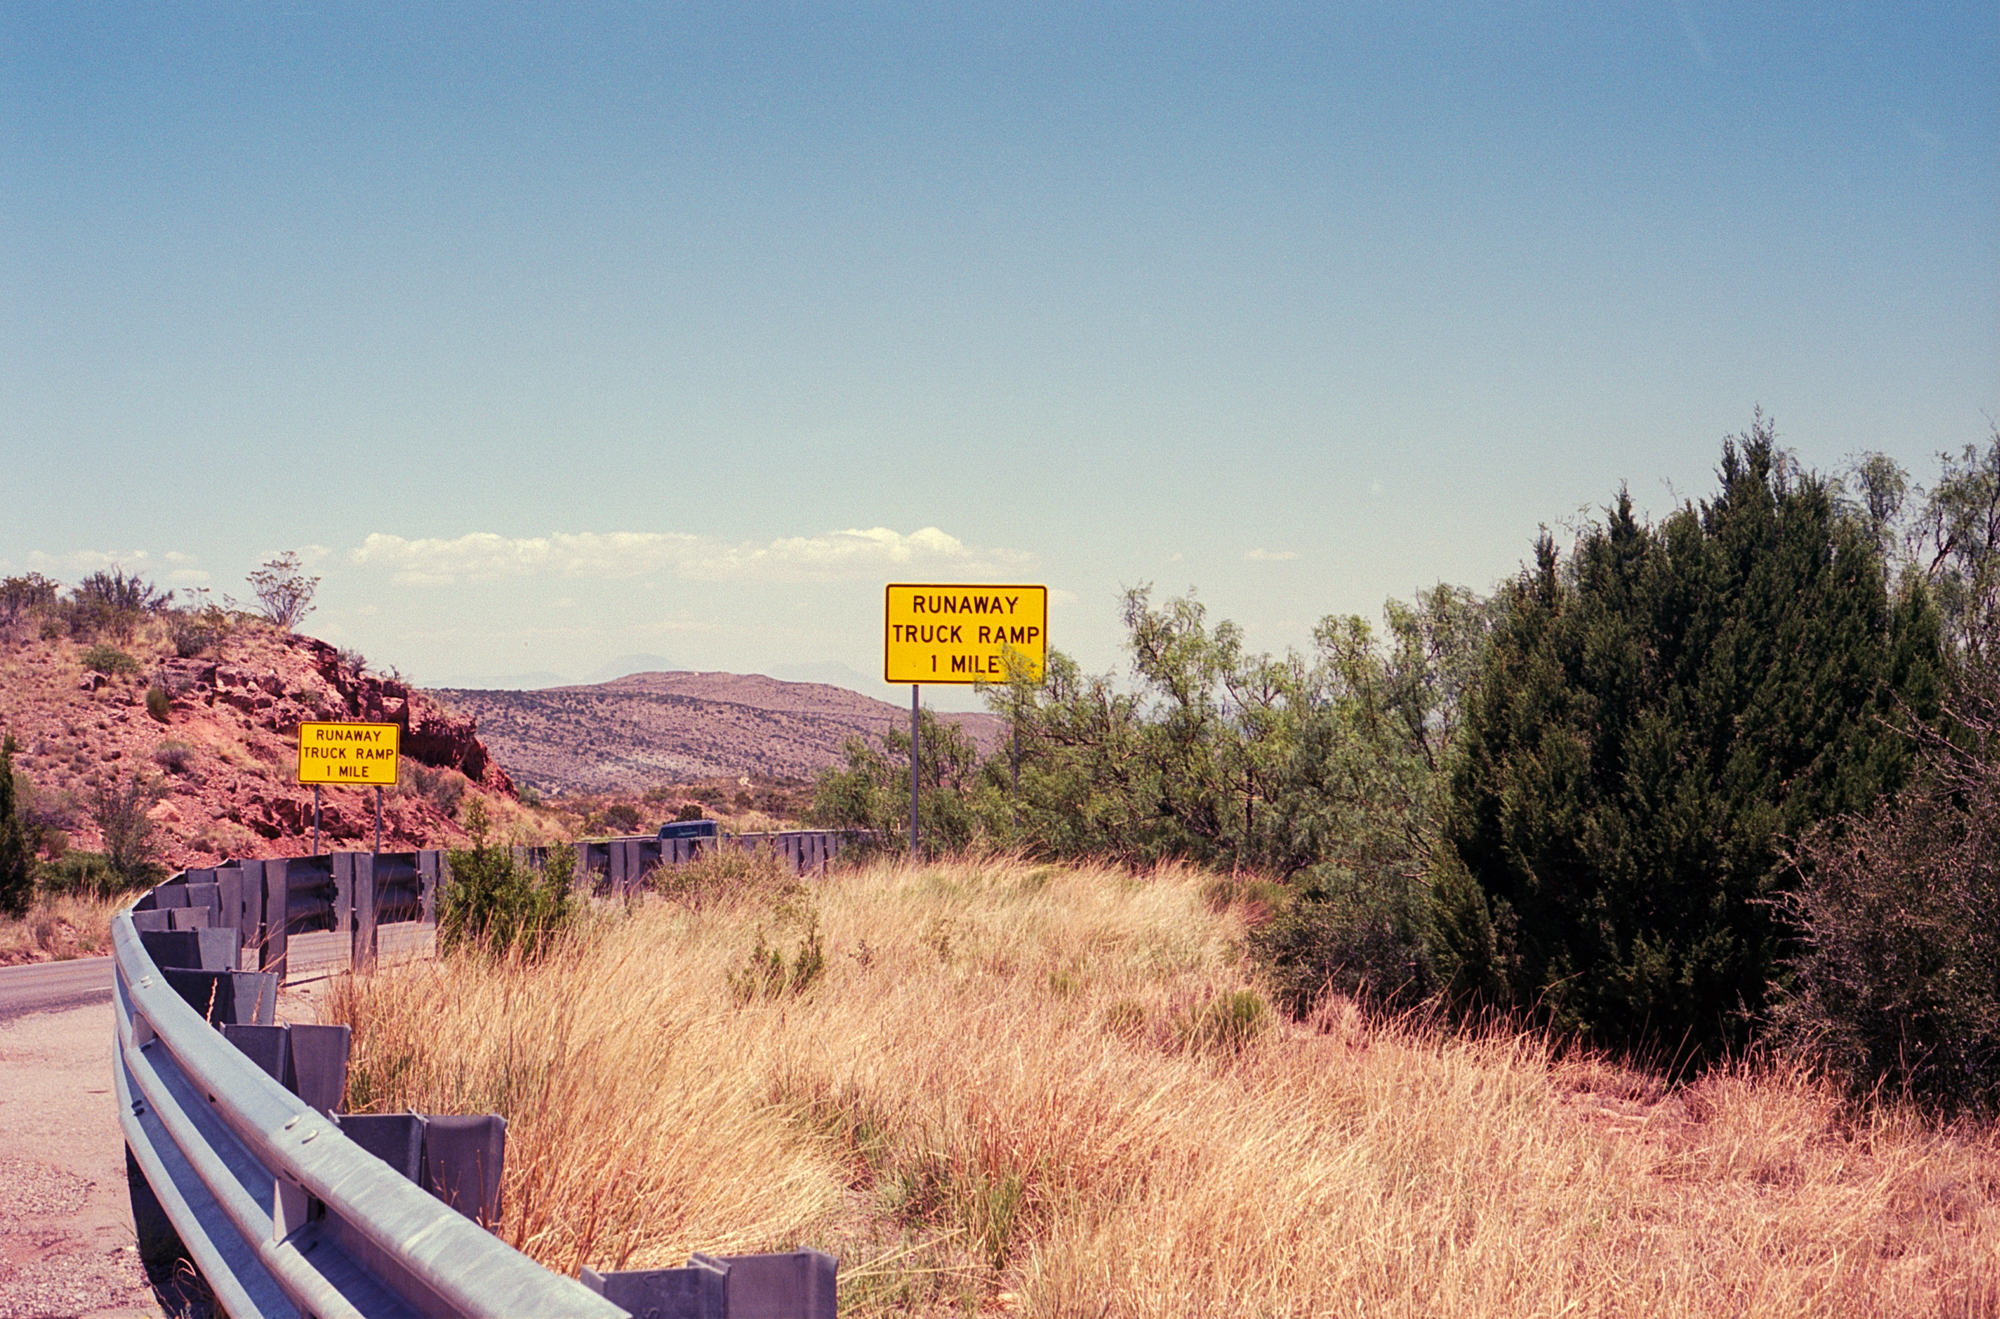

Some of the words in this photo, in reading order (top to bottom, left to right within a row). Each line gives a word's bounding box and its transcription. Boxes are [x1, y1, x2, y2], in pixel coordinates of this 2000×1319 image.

[913, 595, 1019, 614] RUNAWAY
[892, 624, 963, 644] TRUCK
[979, 625, 1040, 644] RAMP
[931, 655, 937, 673] 1
[951, 655, 1000, 674] MILE
[316, 729, 382, 741] RUNAWAY
[303, 746, 347, 759] TRUCK
[356, 748, 394, 760] RAMP
[326, 765, 331, 777] 1
[339, 766, 369, 778] MILE
